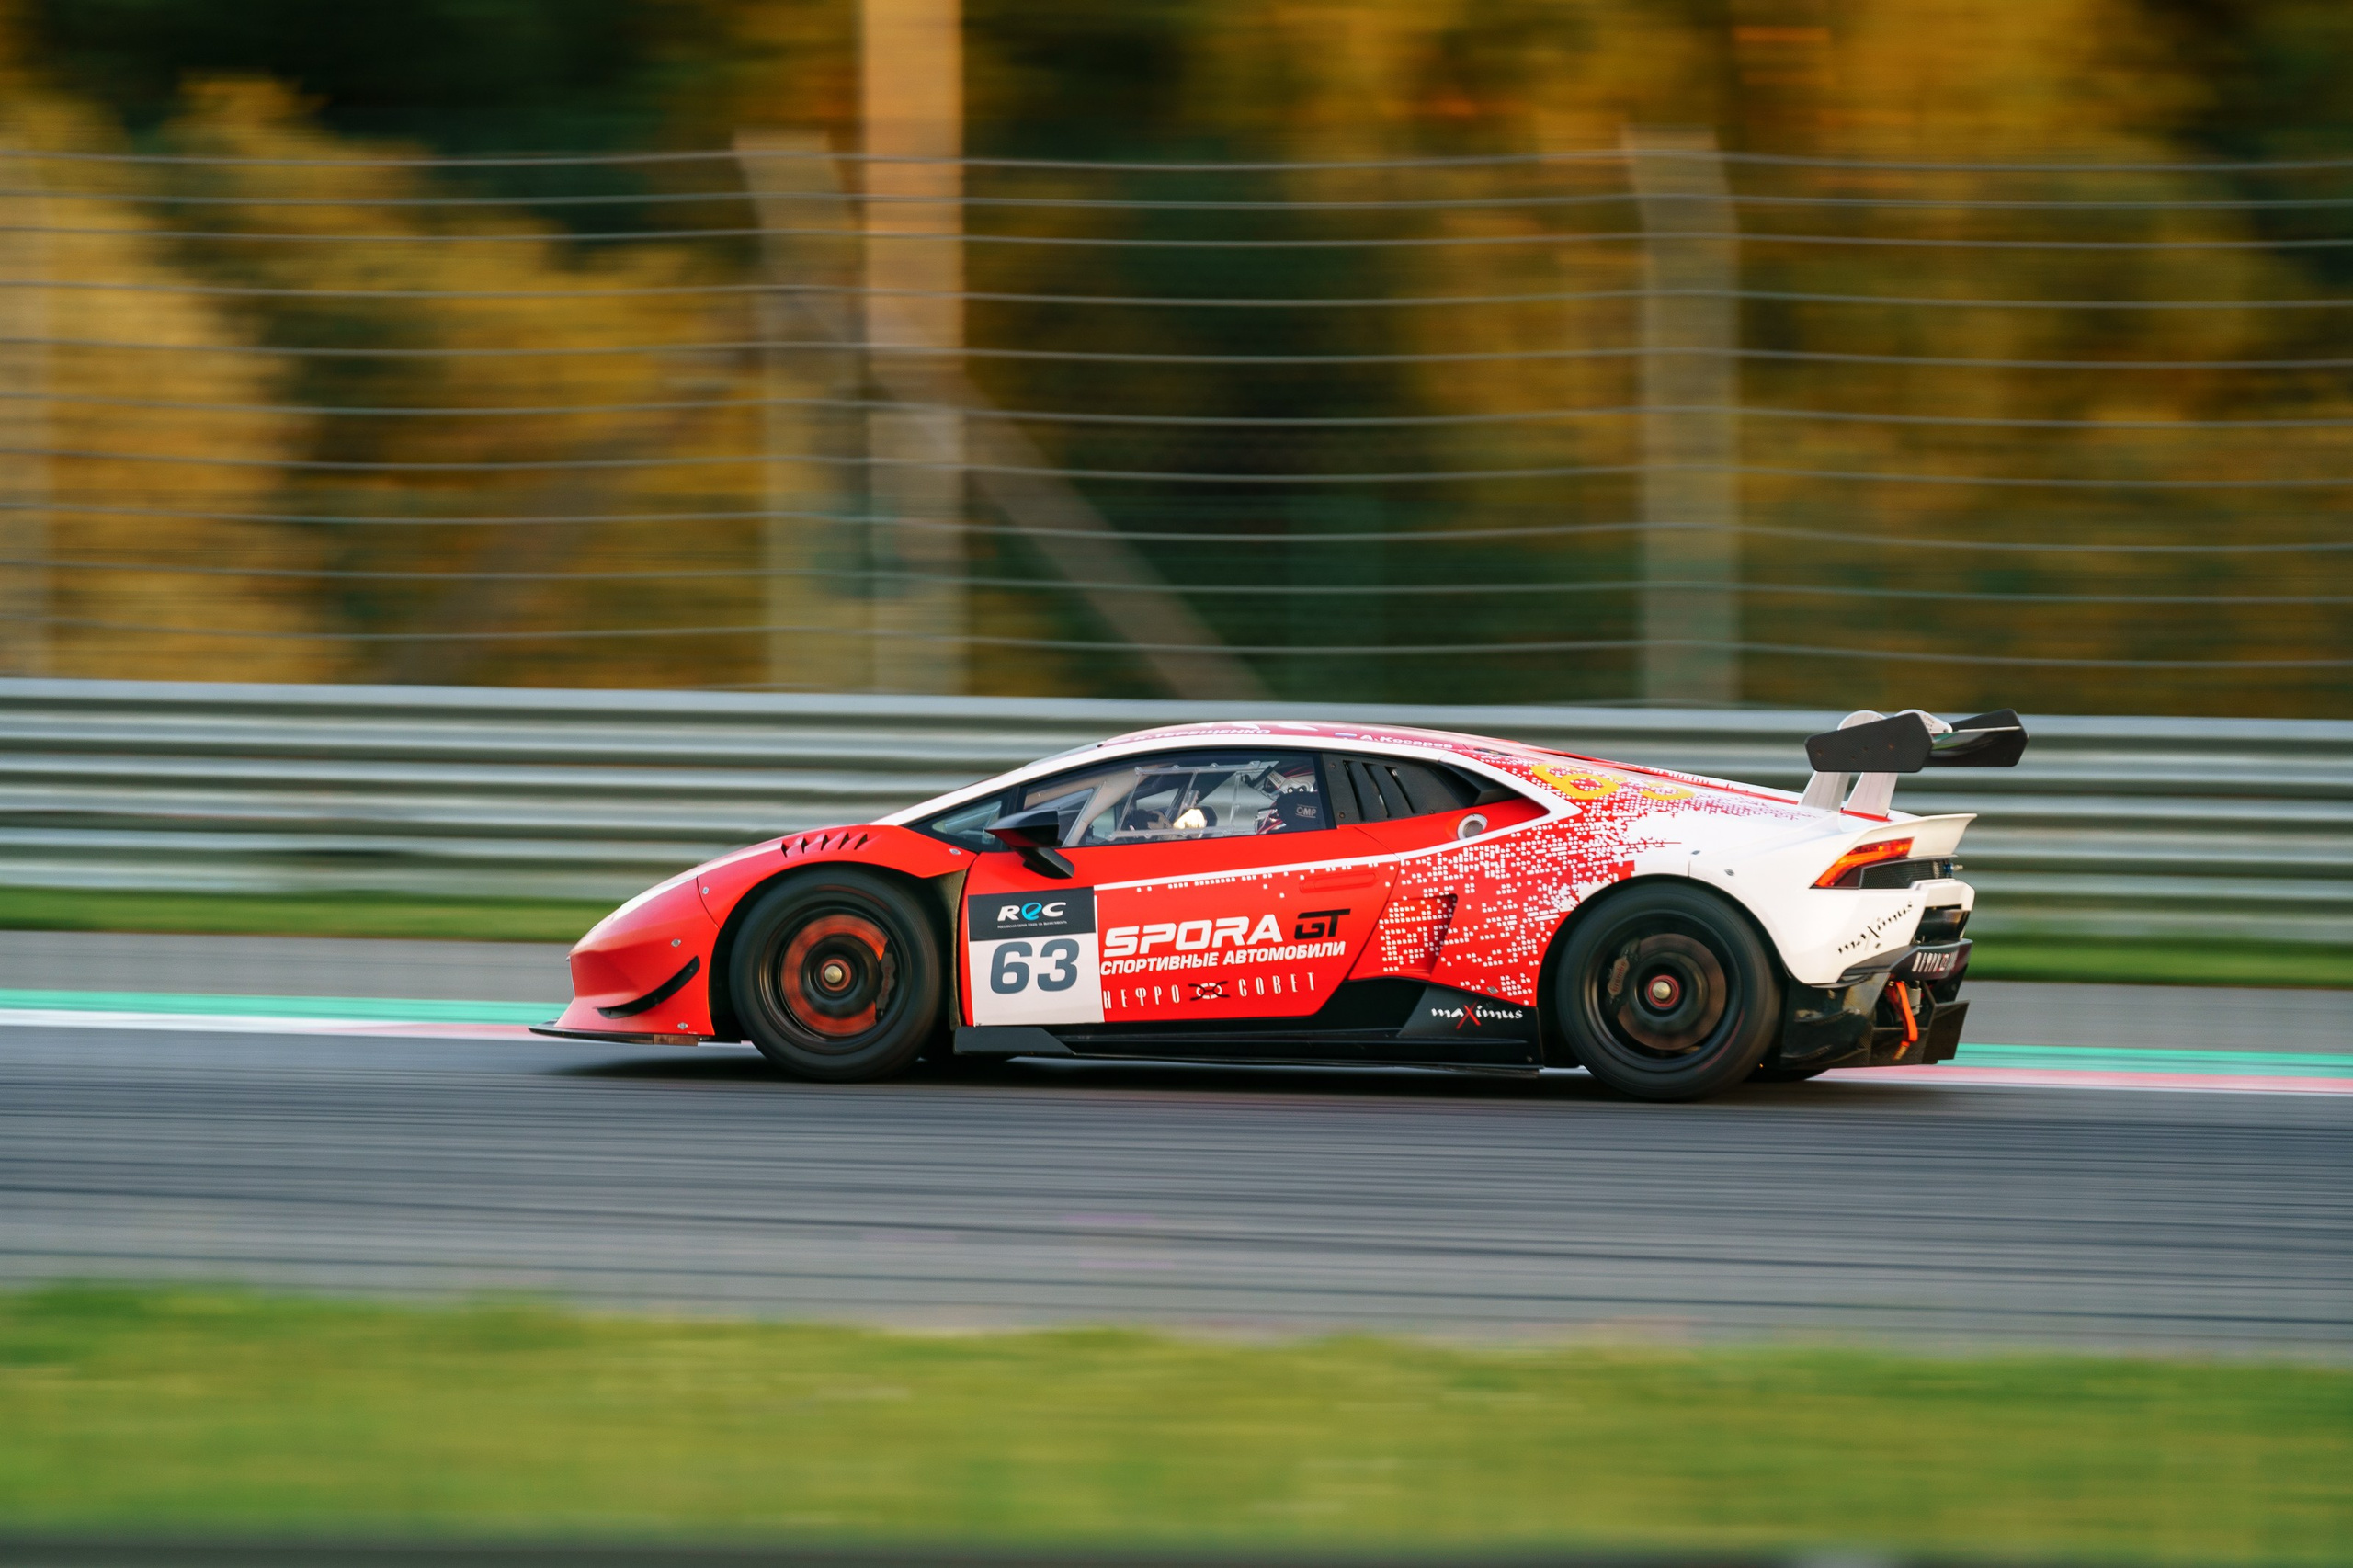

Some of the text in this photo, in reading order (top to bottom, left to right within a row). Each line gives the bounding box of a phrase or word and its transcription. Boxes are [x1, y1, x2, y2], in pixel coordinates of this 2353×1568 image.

[1103, 908, 1351, 958] SPORA GT
[990, 938, 1080, 994] 63
[1100, 940, 1347, 976] СПОРТИВНЫЕ АВТОМОБИЛИ
[1102, 971, 1315, 1009] НЕФРО СОВЕТ
